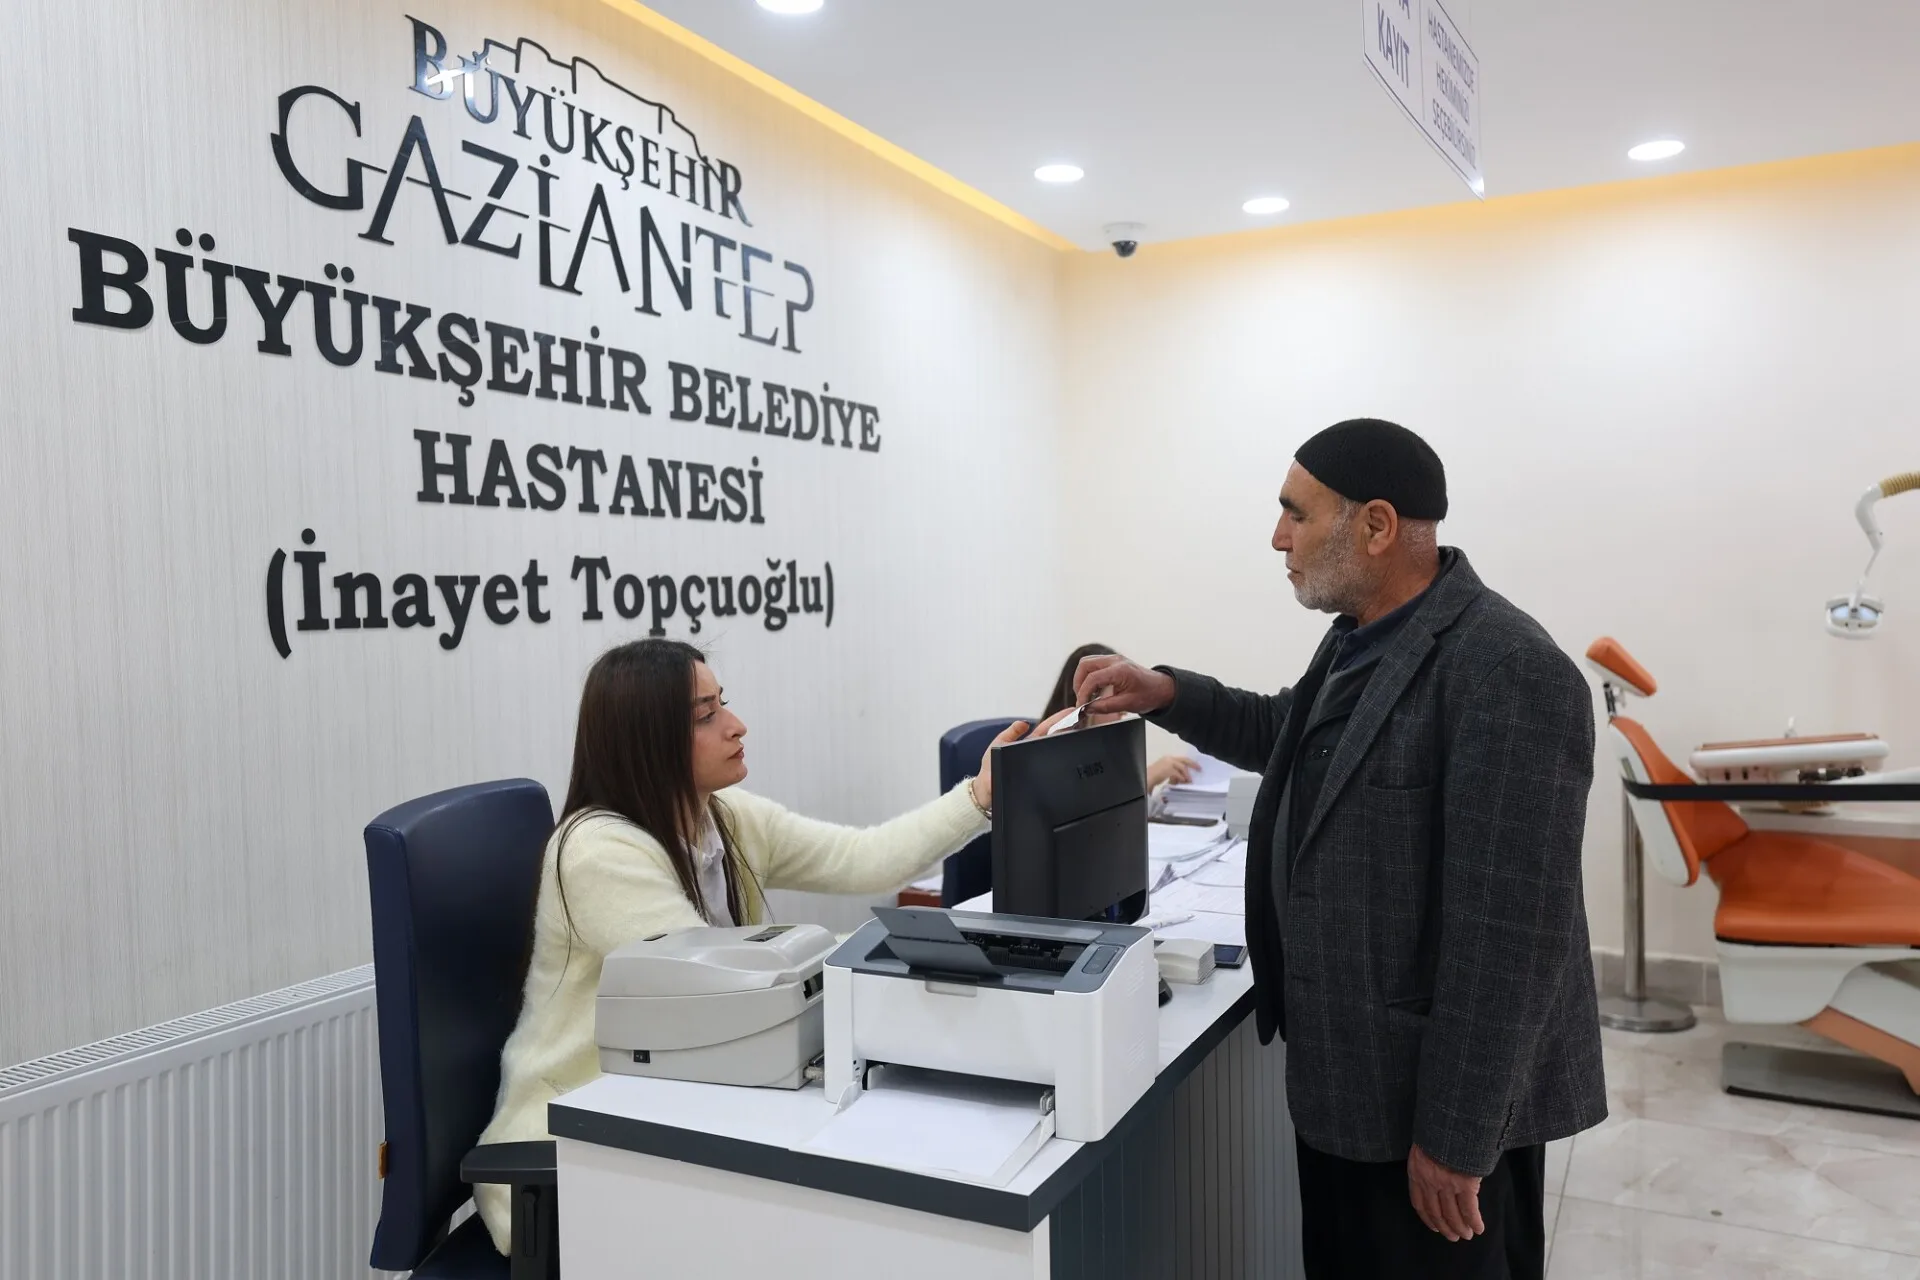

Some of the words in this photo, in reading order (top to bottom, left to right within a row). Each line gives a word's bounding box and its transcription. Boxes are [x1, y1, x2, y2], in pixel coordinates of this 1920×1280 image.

[405, 14, 752, 227] BÜYÜKŞEHİR
[1377, 2, 1410, 89] KAYIT
[270, 85, 815, 354] GAZİANTEP
[68, 227, 652, 415] BÜYÜKŞEHİR
[668, 360, 881, 453] BELEDİYE
[413, 430, 765, 524] HASTANESİ
[266, 528, 551, 659] (İnayet
[570, 555, 834, 637] Topçuoğlu)
